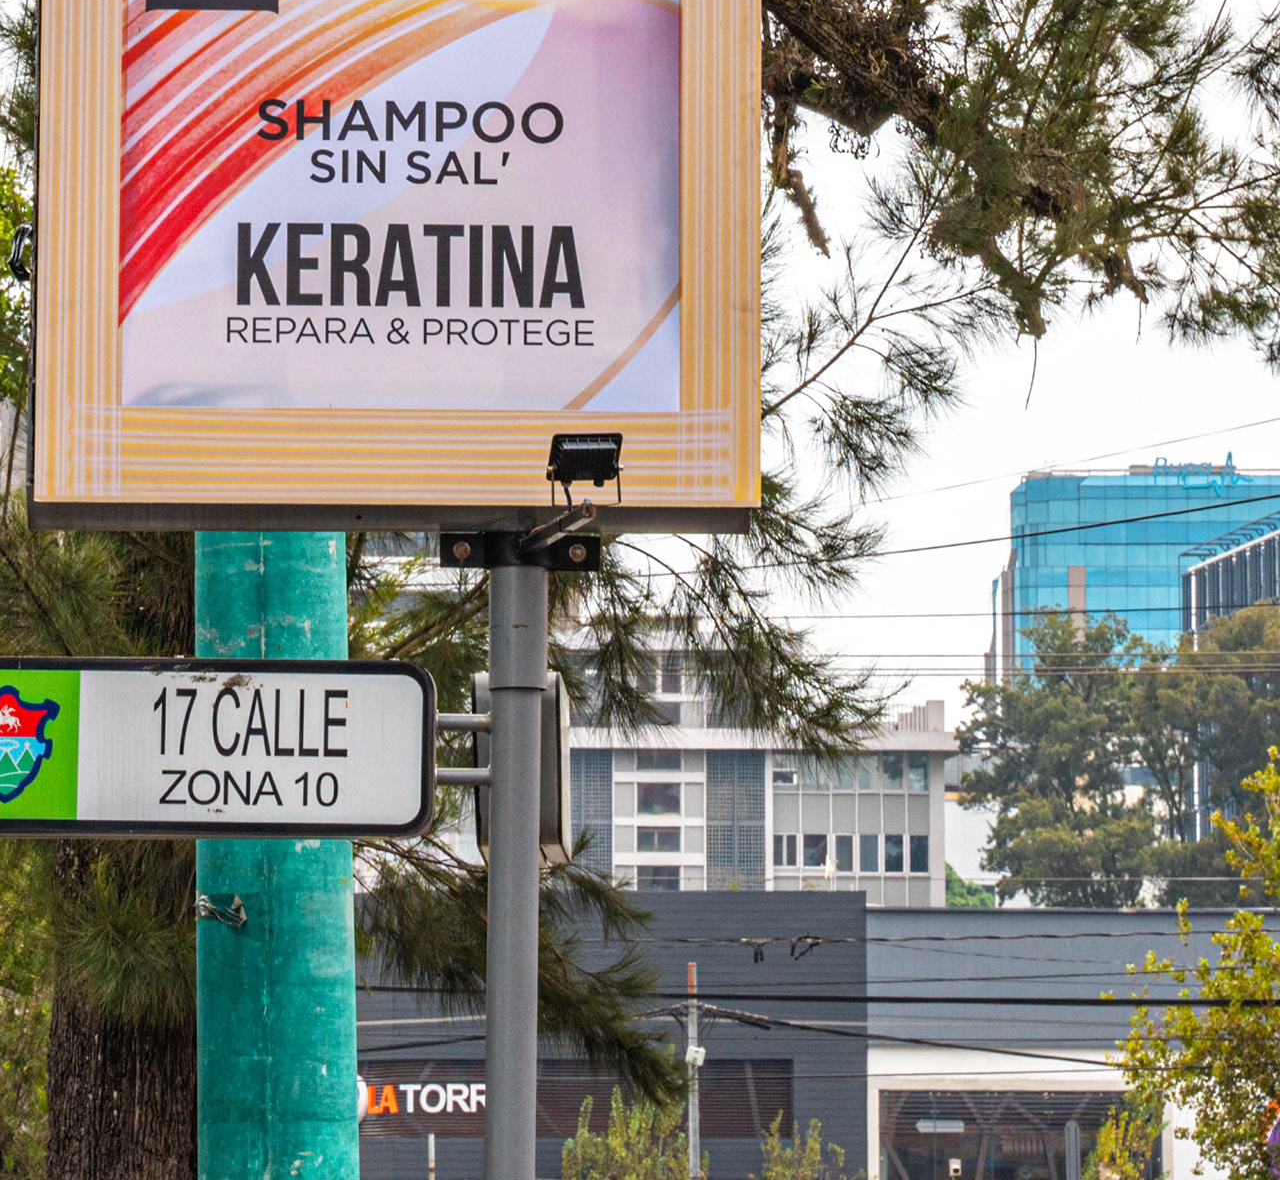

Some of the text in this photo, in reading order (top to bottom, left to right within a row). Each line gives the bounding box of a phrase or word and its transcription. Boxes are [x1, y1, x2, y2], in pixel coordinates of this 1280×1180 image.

[256, 99, 565, 144] SHAMPOO
[309, 149, 387, 184] SIN
[236, 222, 586, 309] KERATINA
[226, 316, 595, 347] REPARA & PROTEGE
[153, 687, 349, 758] 17 CALLE
[158, 769, 339, 807] ZONA 10
[366, 1083, 486, 1115] LA TORR
